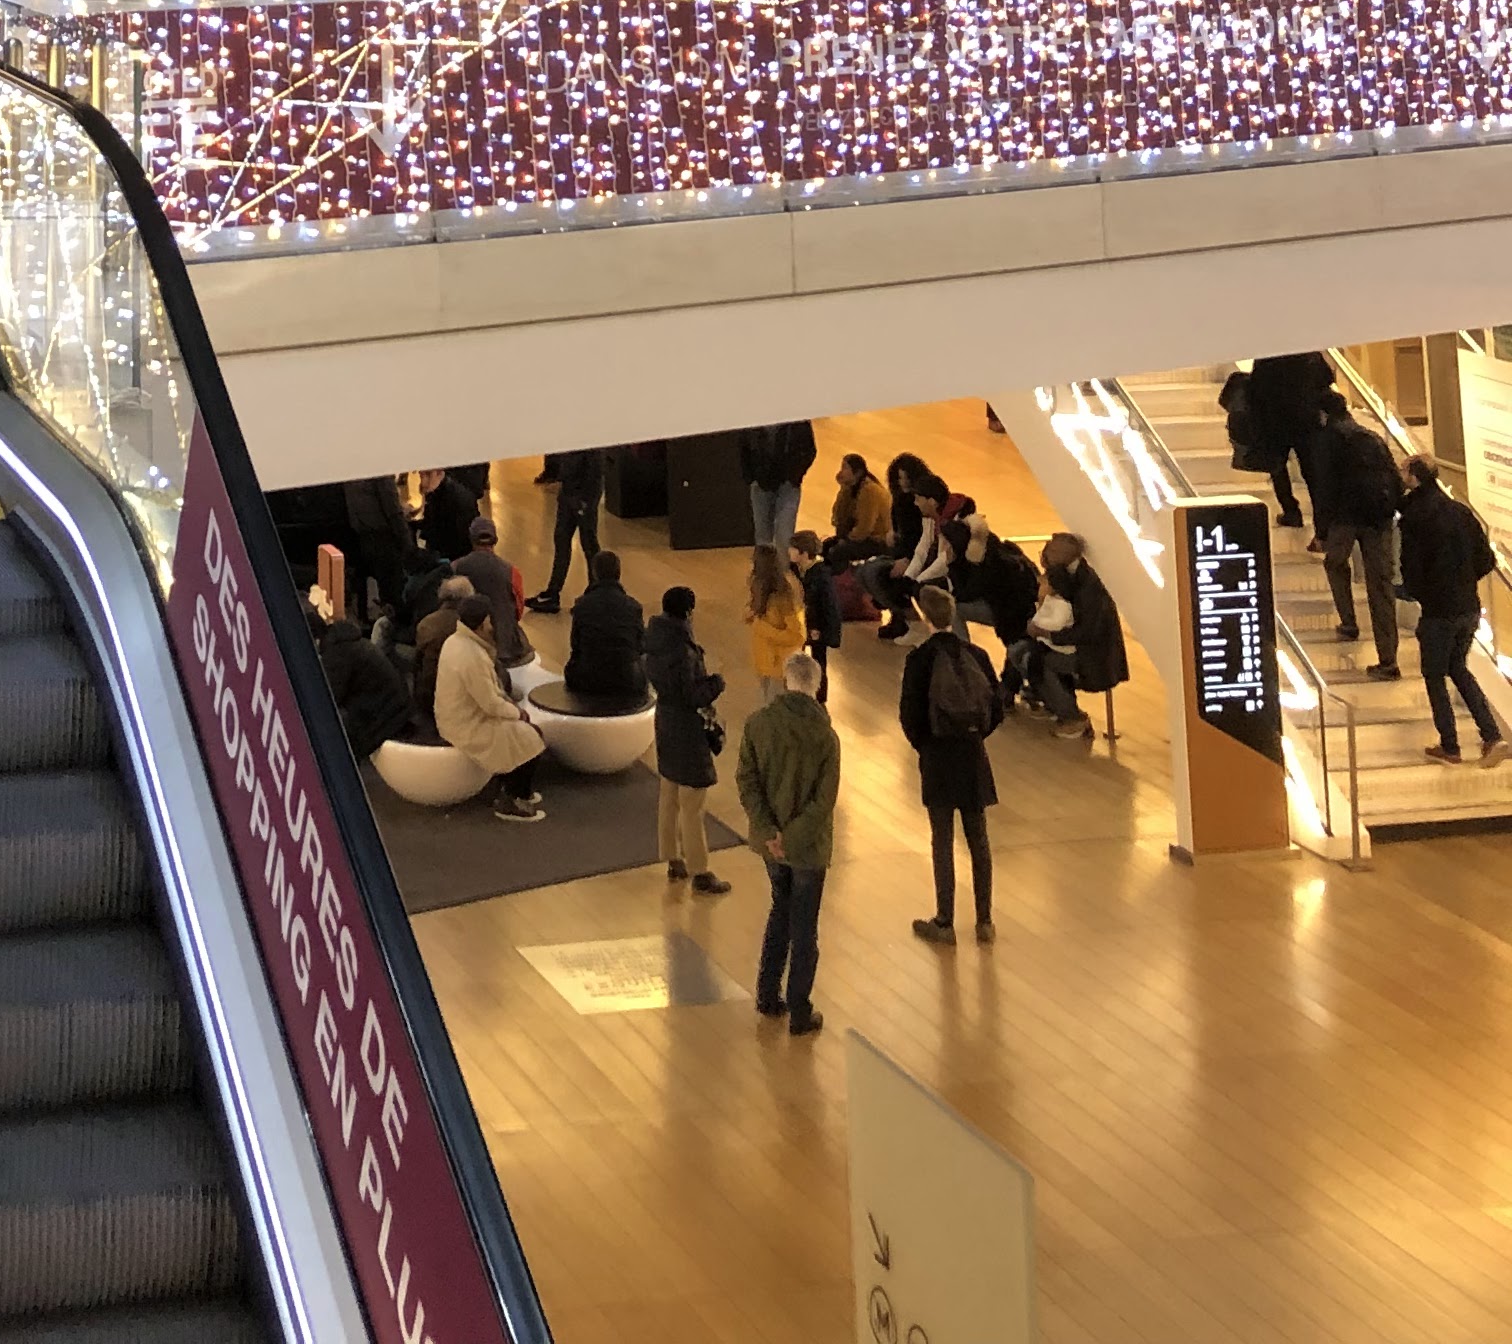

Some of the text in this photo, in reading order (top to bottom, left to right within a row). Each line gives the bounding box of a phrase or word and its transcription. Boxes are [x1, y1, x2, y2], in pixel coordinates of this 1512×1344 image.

[192, 593, 436, 1344] SHOPPING EN PLU
[203, 507, 408, 1172] DES HEURES DE
